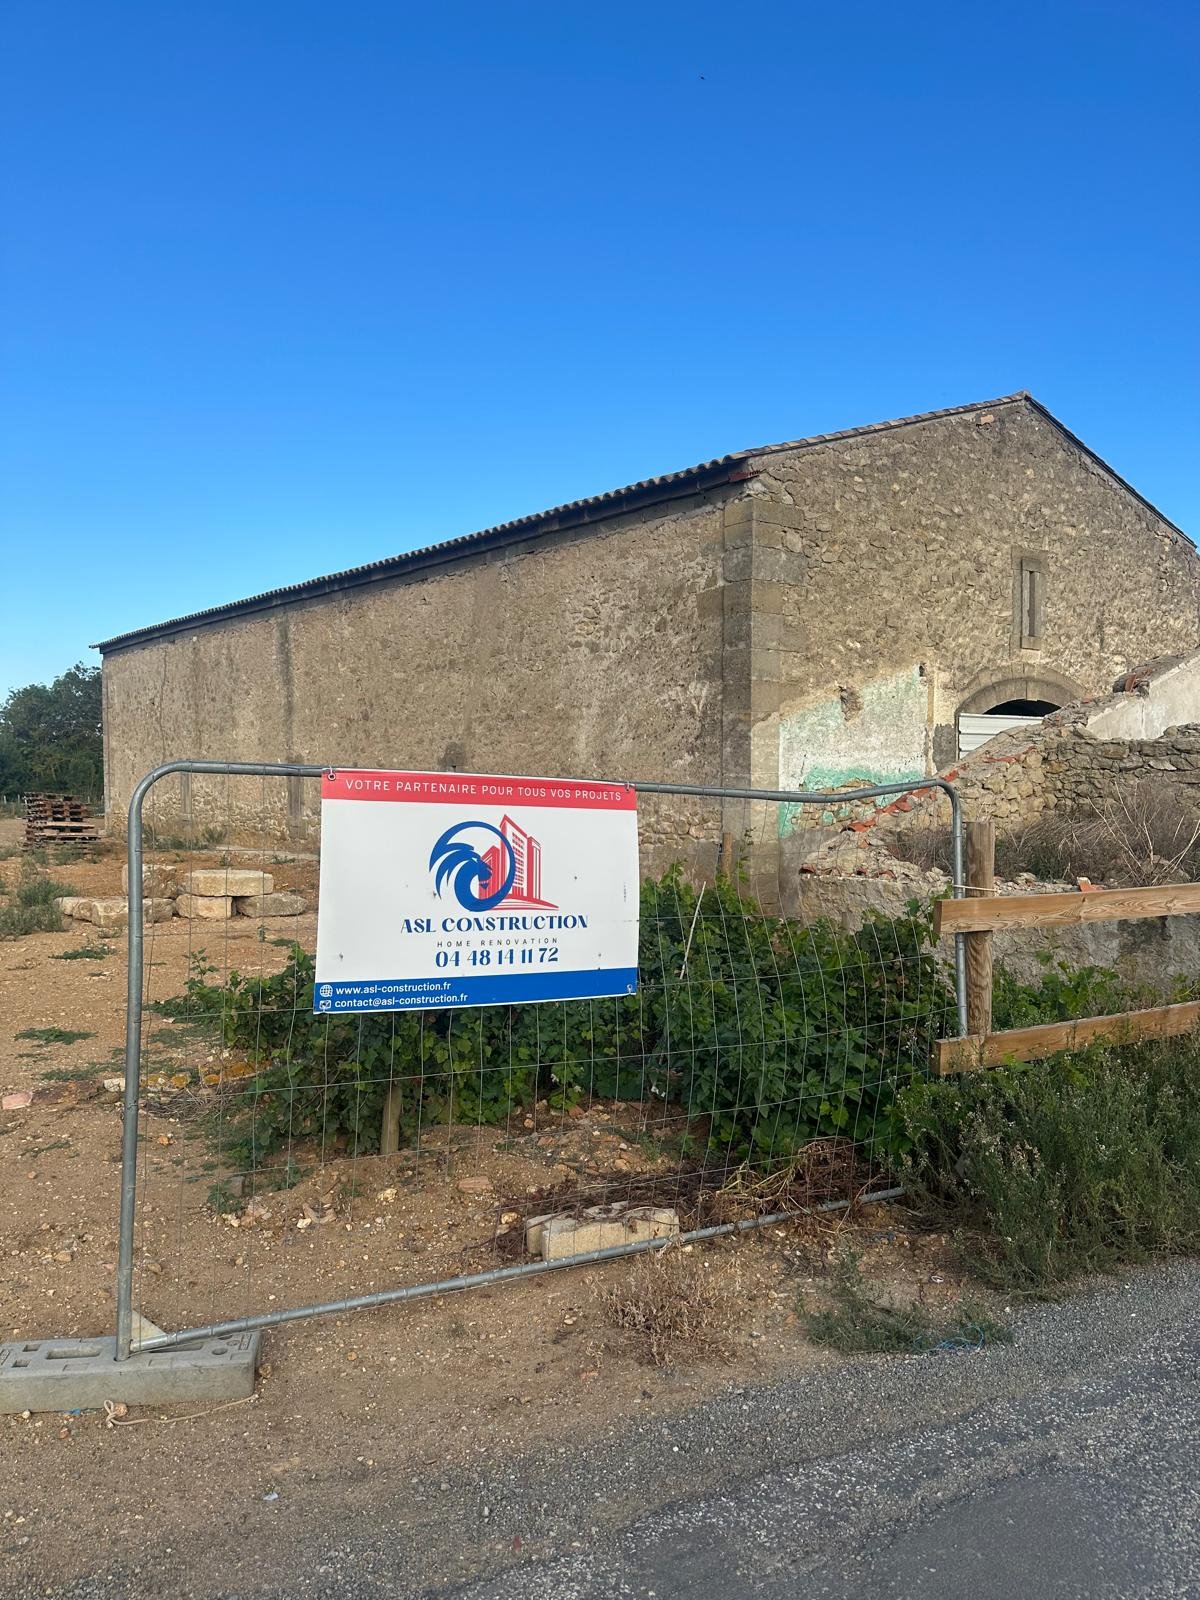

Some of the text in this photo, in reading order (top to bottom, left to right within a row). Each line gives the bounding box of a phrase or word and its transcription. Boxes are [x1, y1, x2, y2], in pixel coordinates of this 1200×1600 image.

[346, 779, 621, 801] VOTRE PARTENAIRE POUR TOUS VOS PROJETS
[401, 915, 588, 933] ASL CONSTRUCTION
[437, 937, 558, 948] HOME RENOVATION
[436, 947, 558, 968] 04 48 14 11 72
[336, 982, 451, 994] www.asl-construction.fr
[335, 994, 468, 1008] contact@asl-construction.fr
